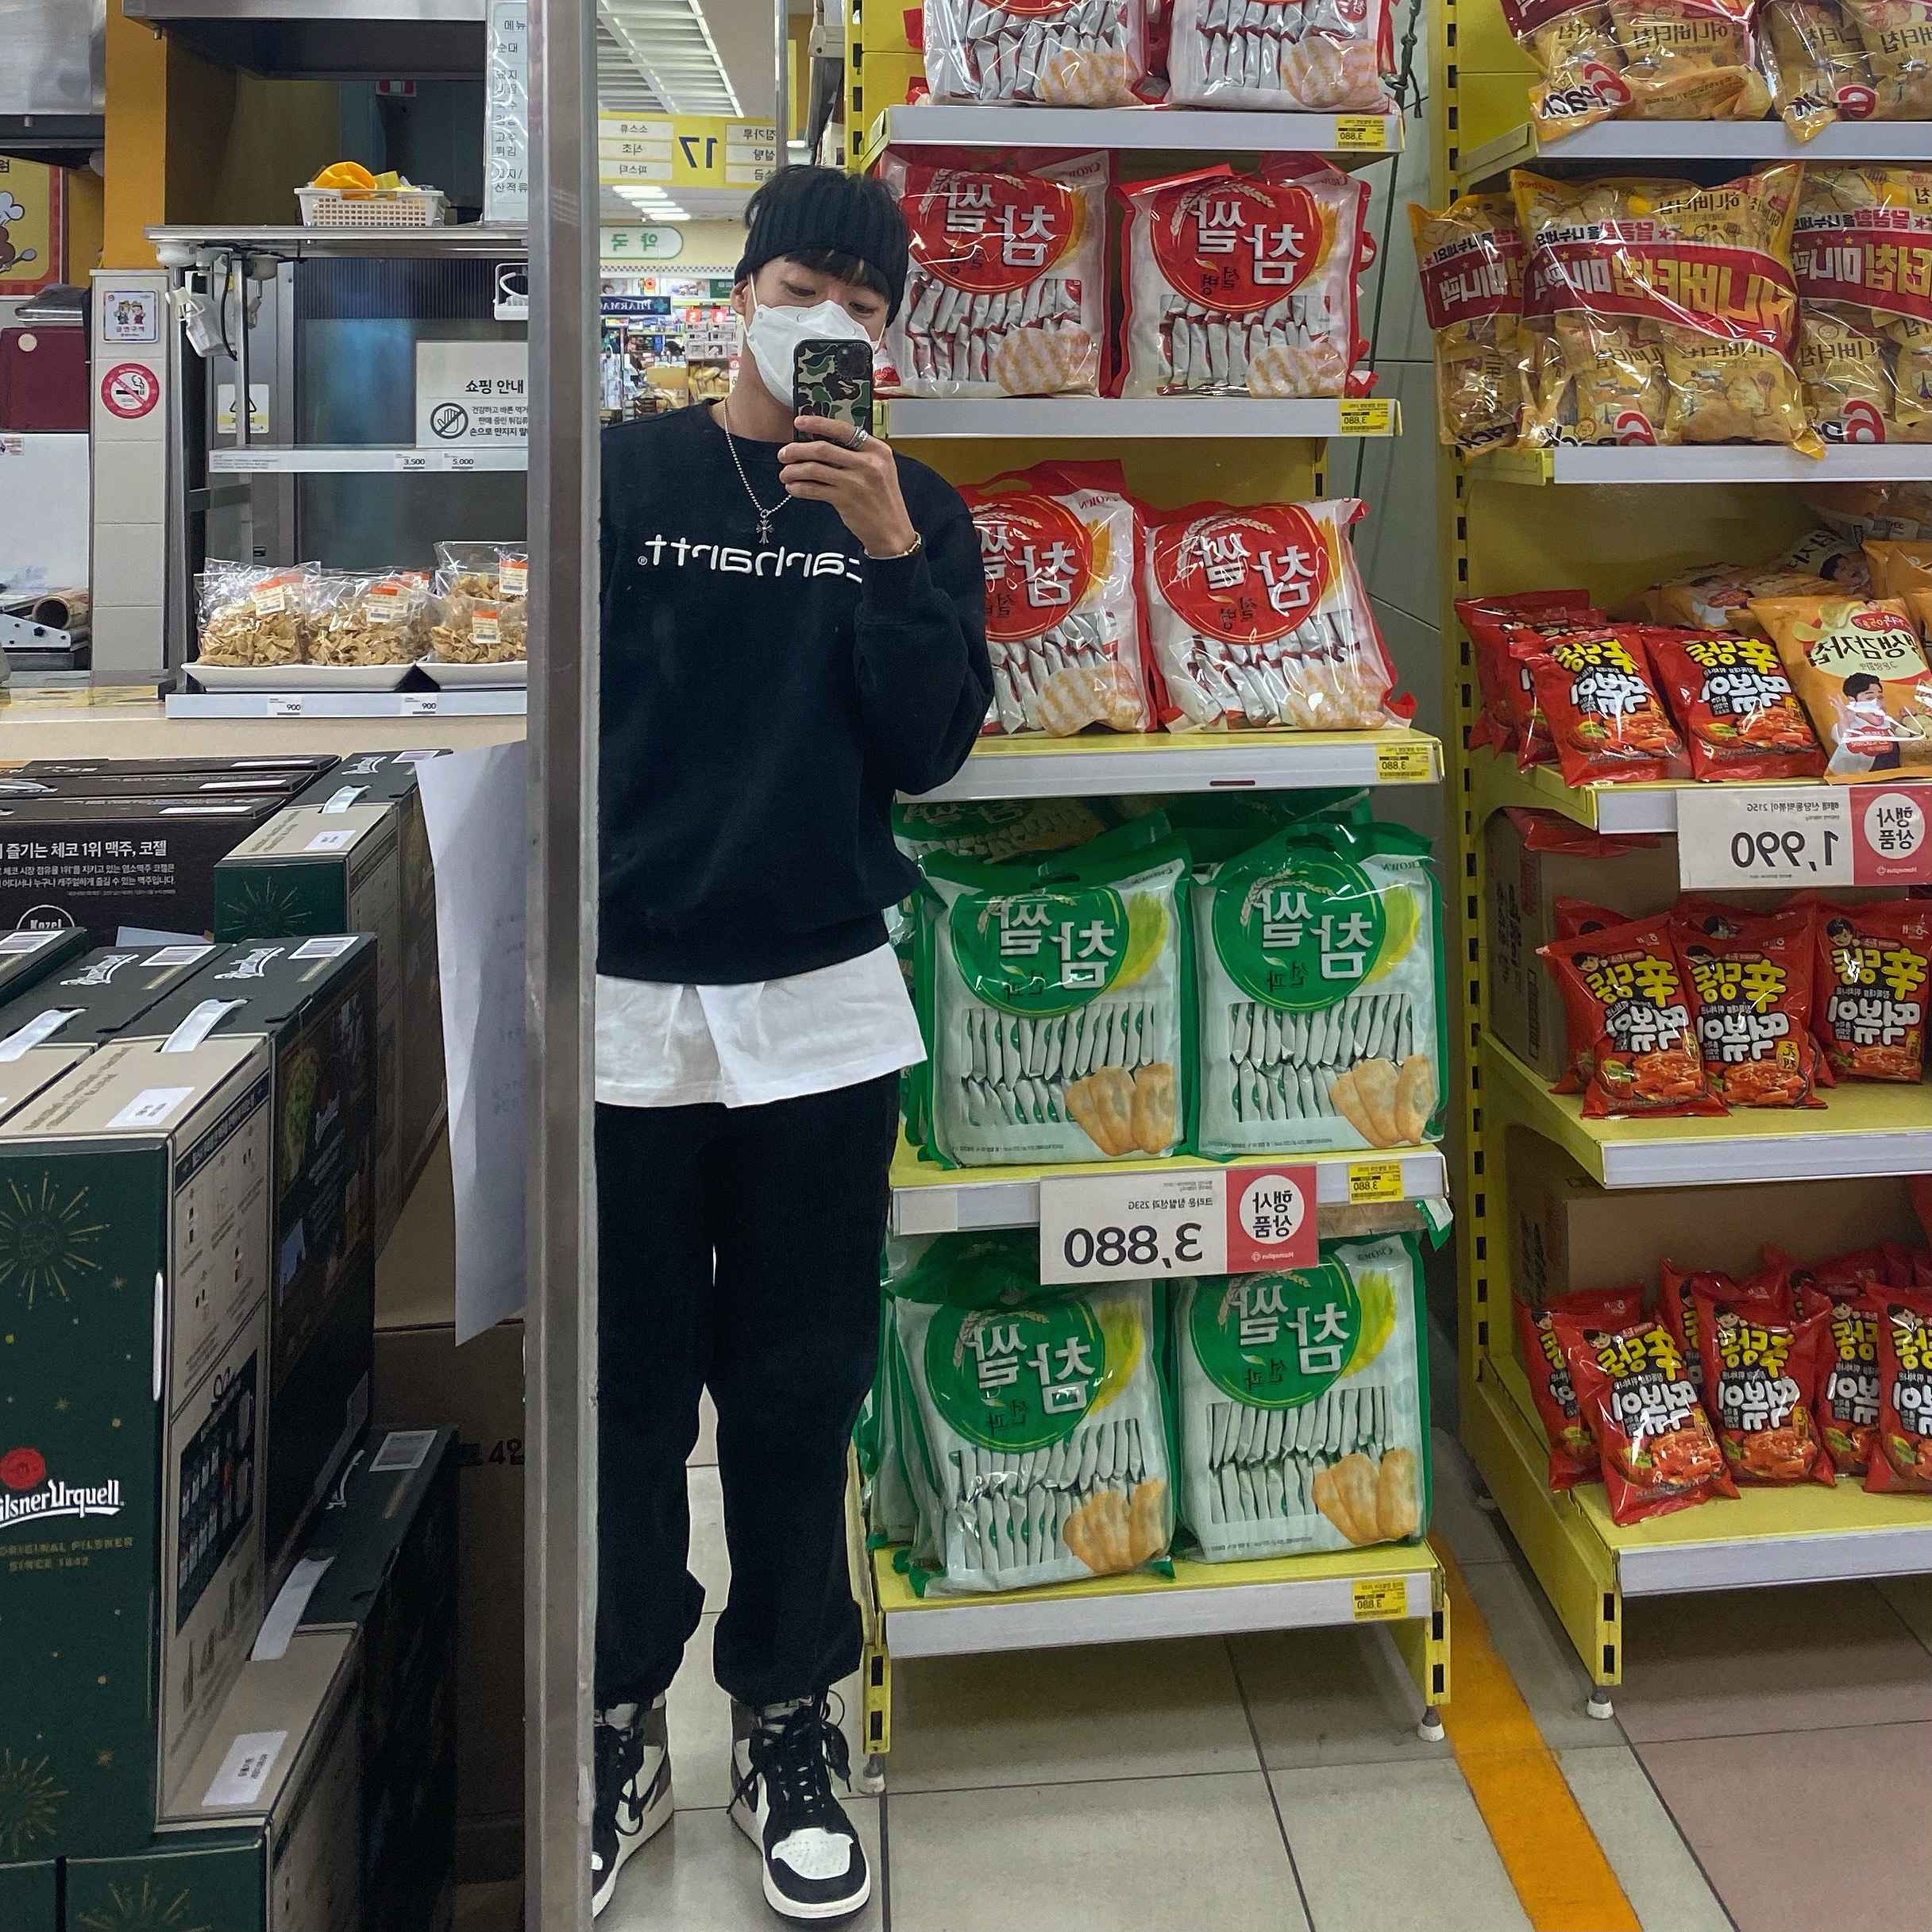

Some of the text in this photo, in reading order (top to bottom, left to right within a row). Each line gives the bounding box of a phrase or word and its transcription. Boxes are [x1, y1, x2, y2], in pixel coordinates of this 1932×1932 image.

[503, 20, 526, 31] 메뉴
[465, 379, 524, 395] 쇼핑 안내
[6, 840, 48, 859] 즐기는
[51, 839, 79, 858] 체코
[82, 840, 102, 858] 1위
[138, 839, 167, 857] 코젤
[48, 1478, 120, 1518] Urquell
